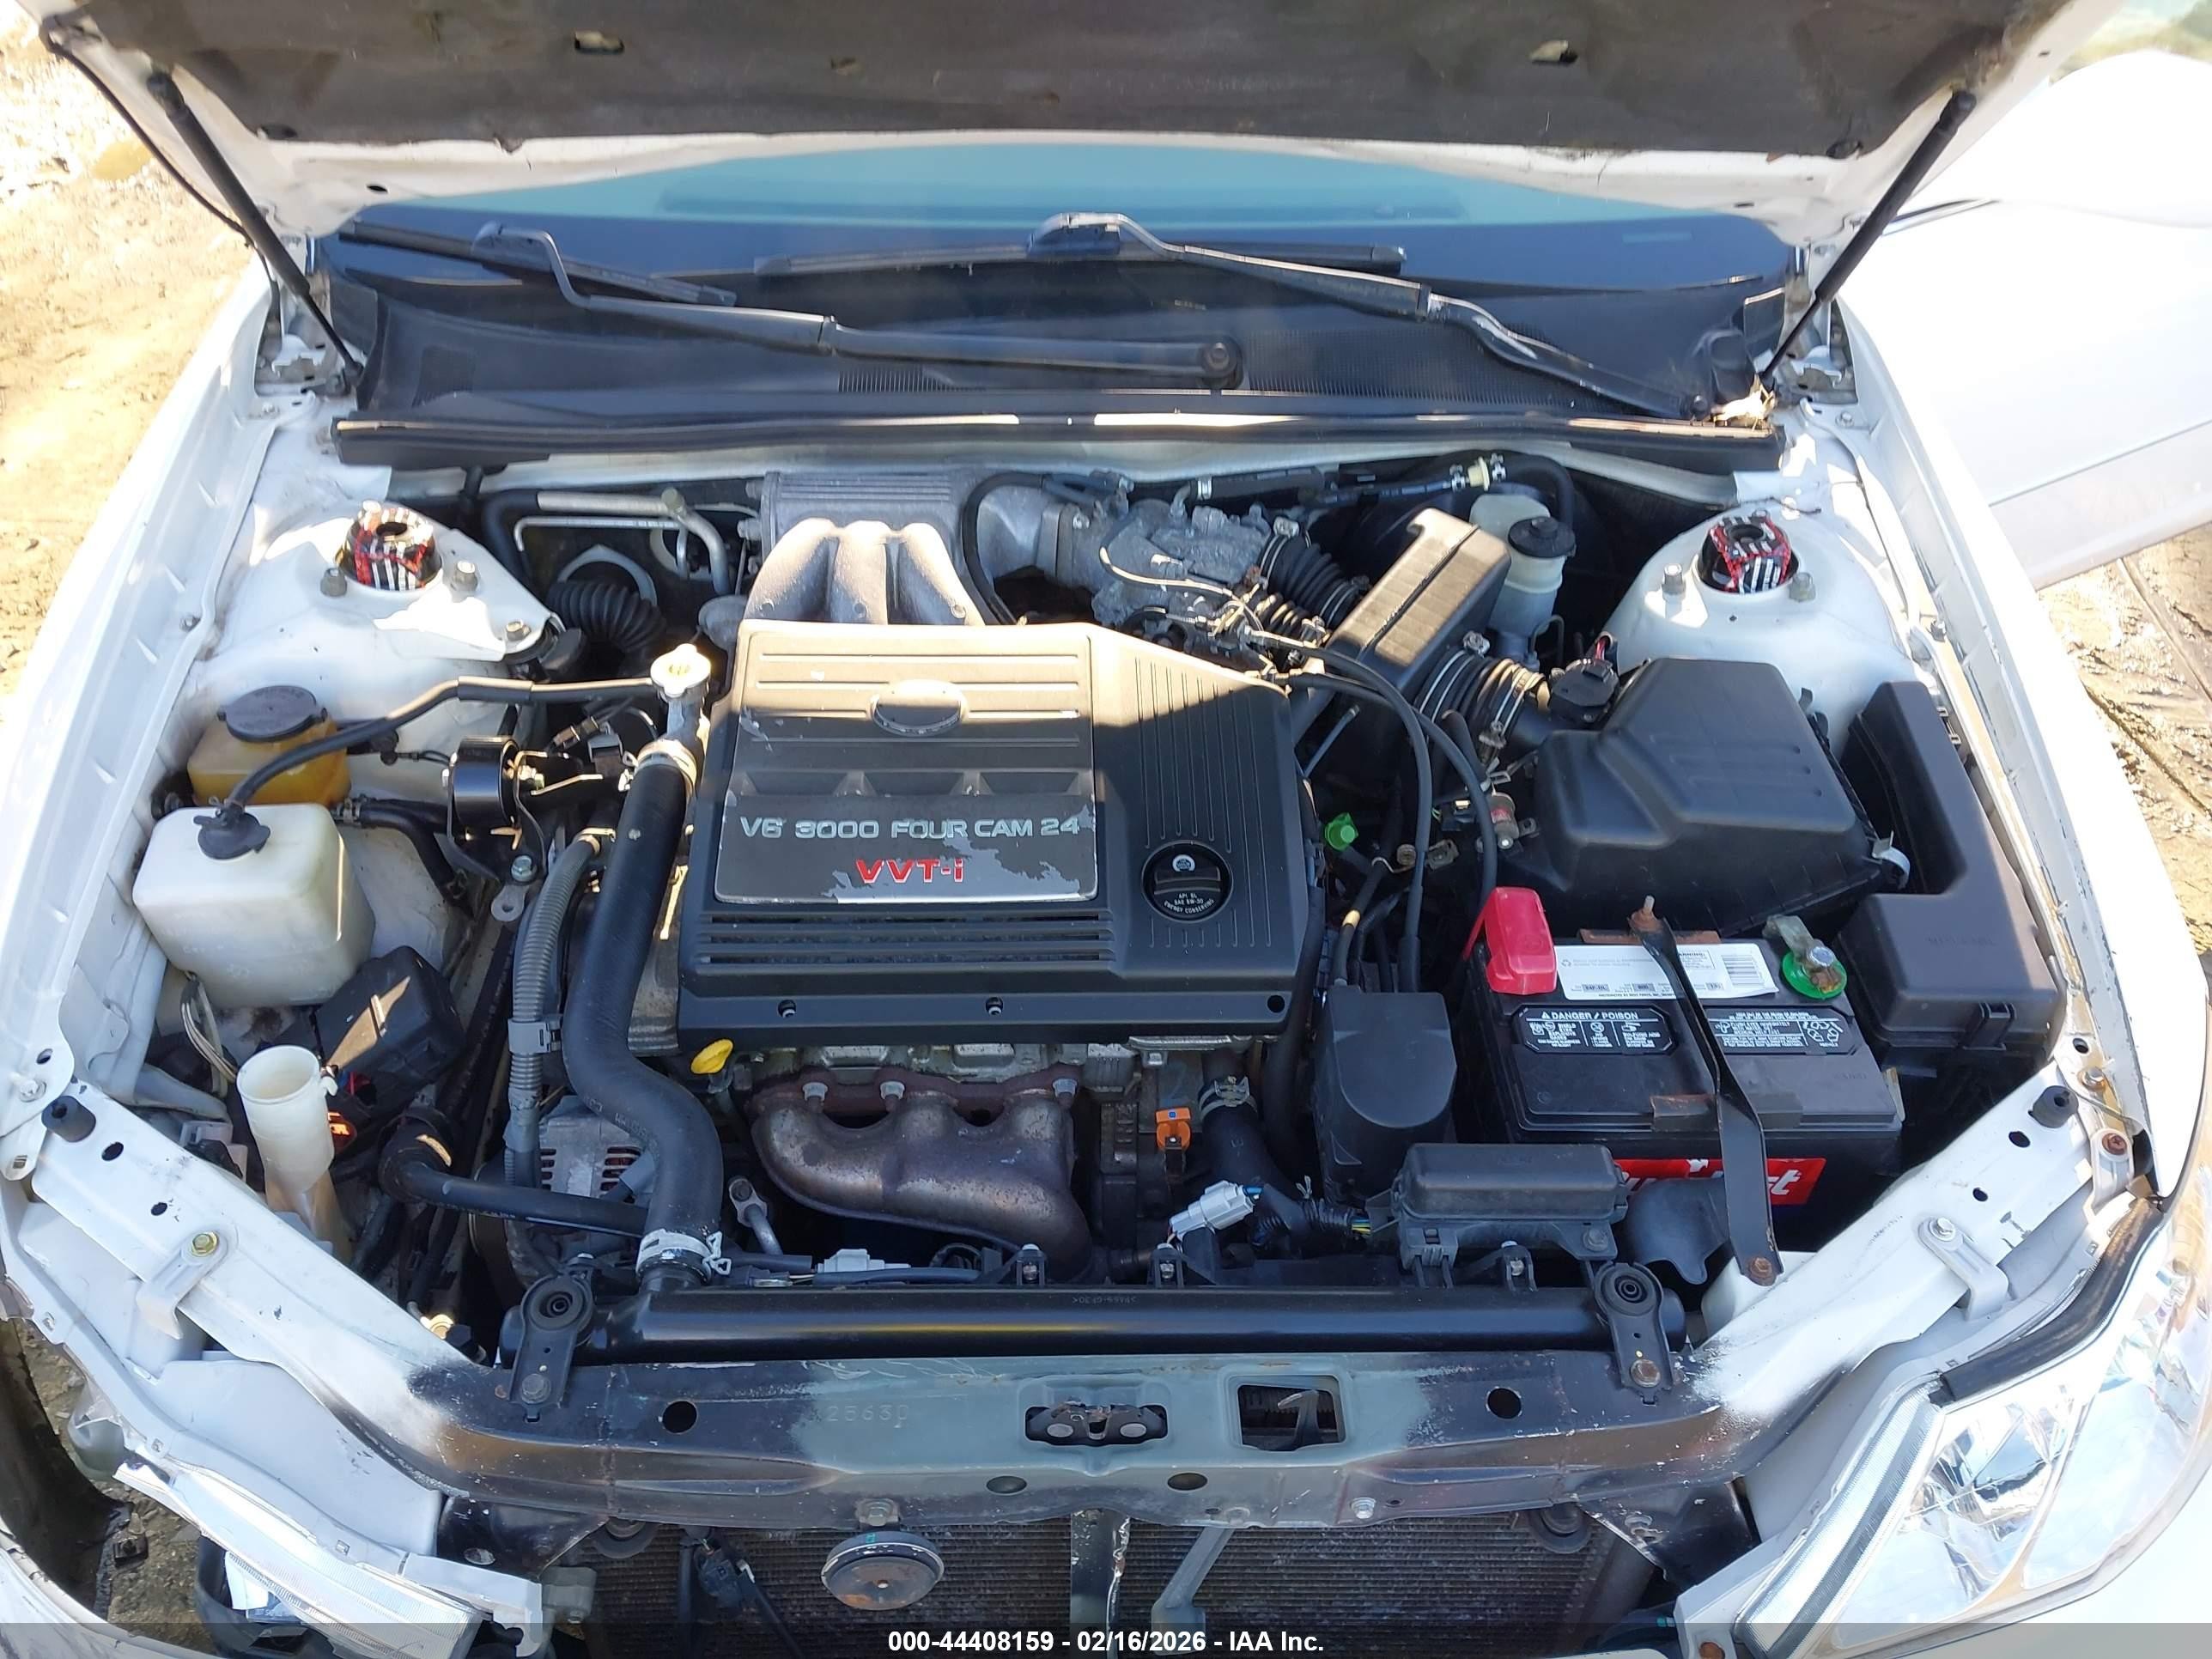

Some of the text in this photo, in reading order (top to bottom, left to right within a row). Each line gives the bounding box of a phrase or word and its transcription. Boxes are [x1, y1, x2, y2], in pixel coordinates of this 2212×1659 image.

[740, 817, 782, 838] V6
[794, 820, 879, 839] 3000
[890, 818, 968, 839] FOUR
[974, 818, 1033, 838] CAM
[855, 859, 963, 883] VVT-i
[1552, 1012, 1593, 1020] DANGER
